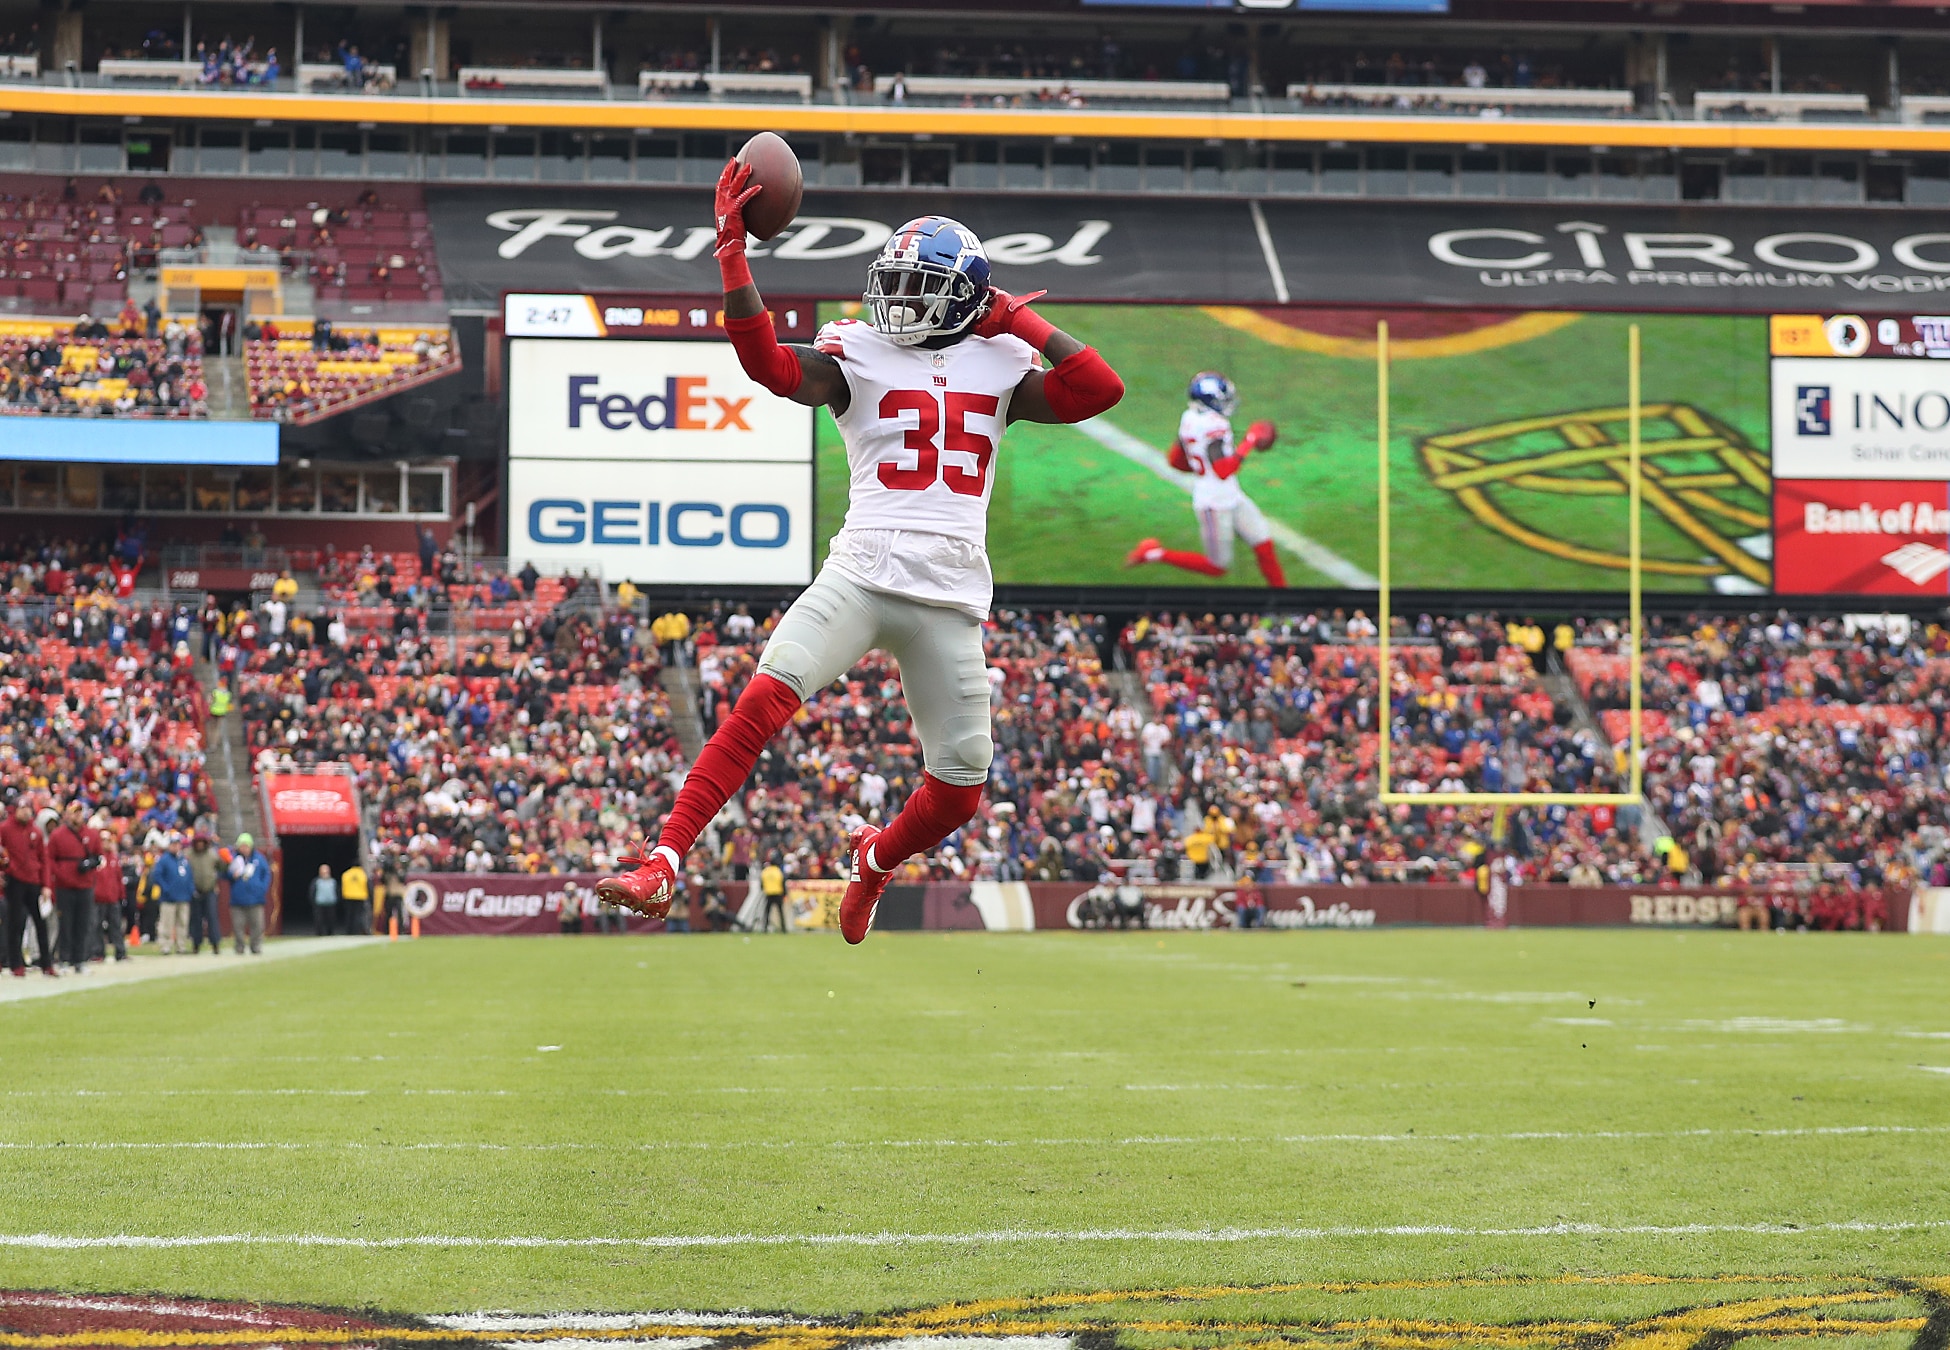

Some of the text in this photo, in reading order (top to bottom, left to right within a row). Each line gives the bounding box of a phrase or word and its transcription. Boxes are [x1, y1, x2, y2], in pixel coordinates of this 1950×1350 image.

[487, 207, 1111, 268] FanDel
[1480, 269, 1618, 288] ULTRA
[1626, 270, 1834, 288] PREMIUM
[526, 307, 572, 324] 2:47
[568, 374, 754, 431] FedEx
[876, 389, 1000, 498] 35
[528, 499, 790, 549] GEICO
[1804, 501, 1880, 534] Bank
[1881, 501, 1914, 534] of
[465, 888, 544, 917] Cause
